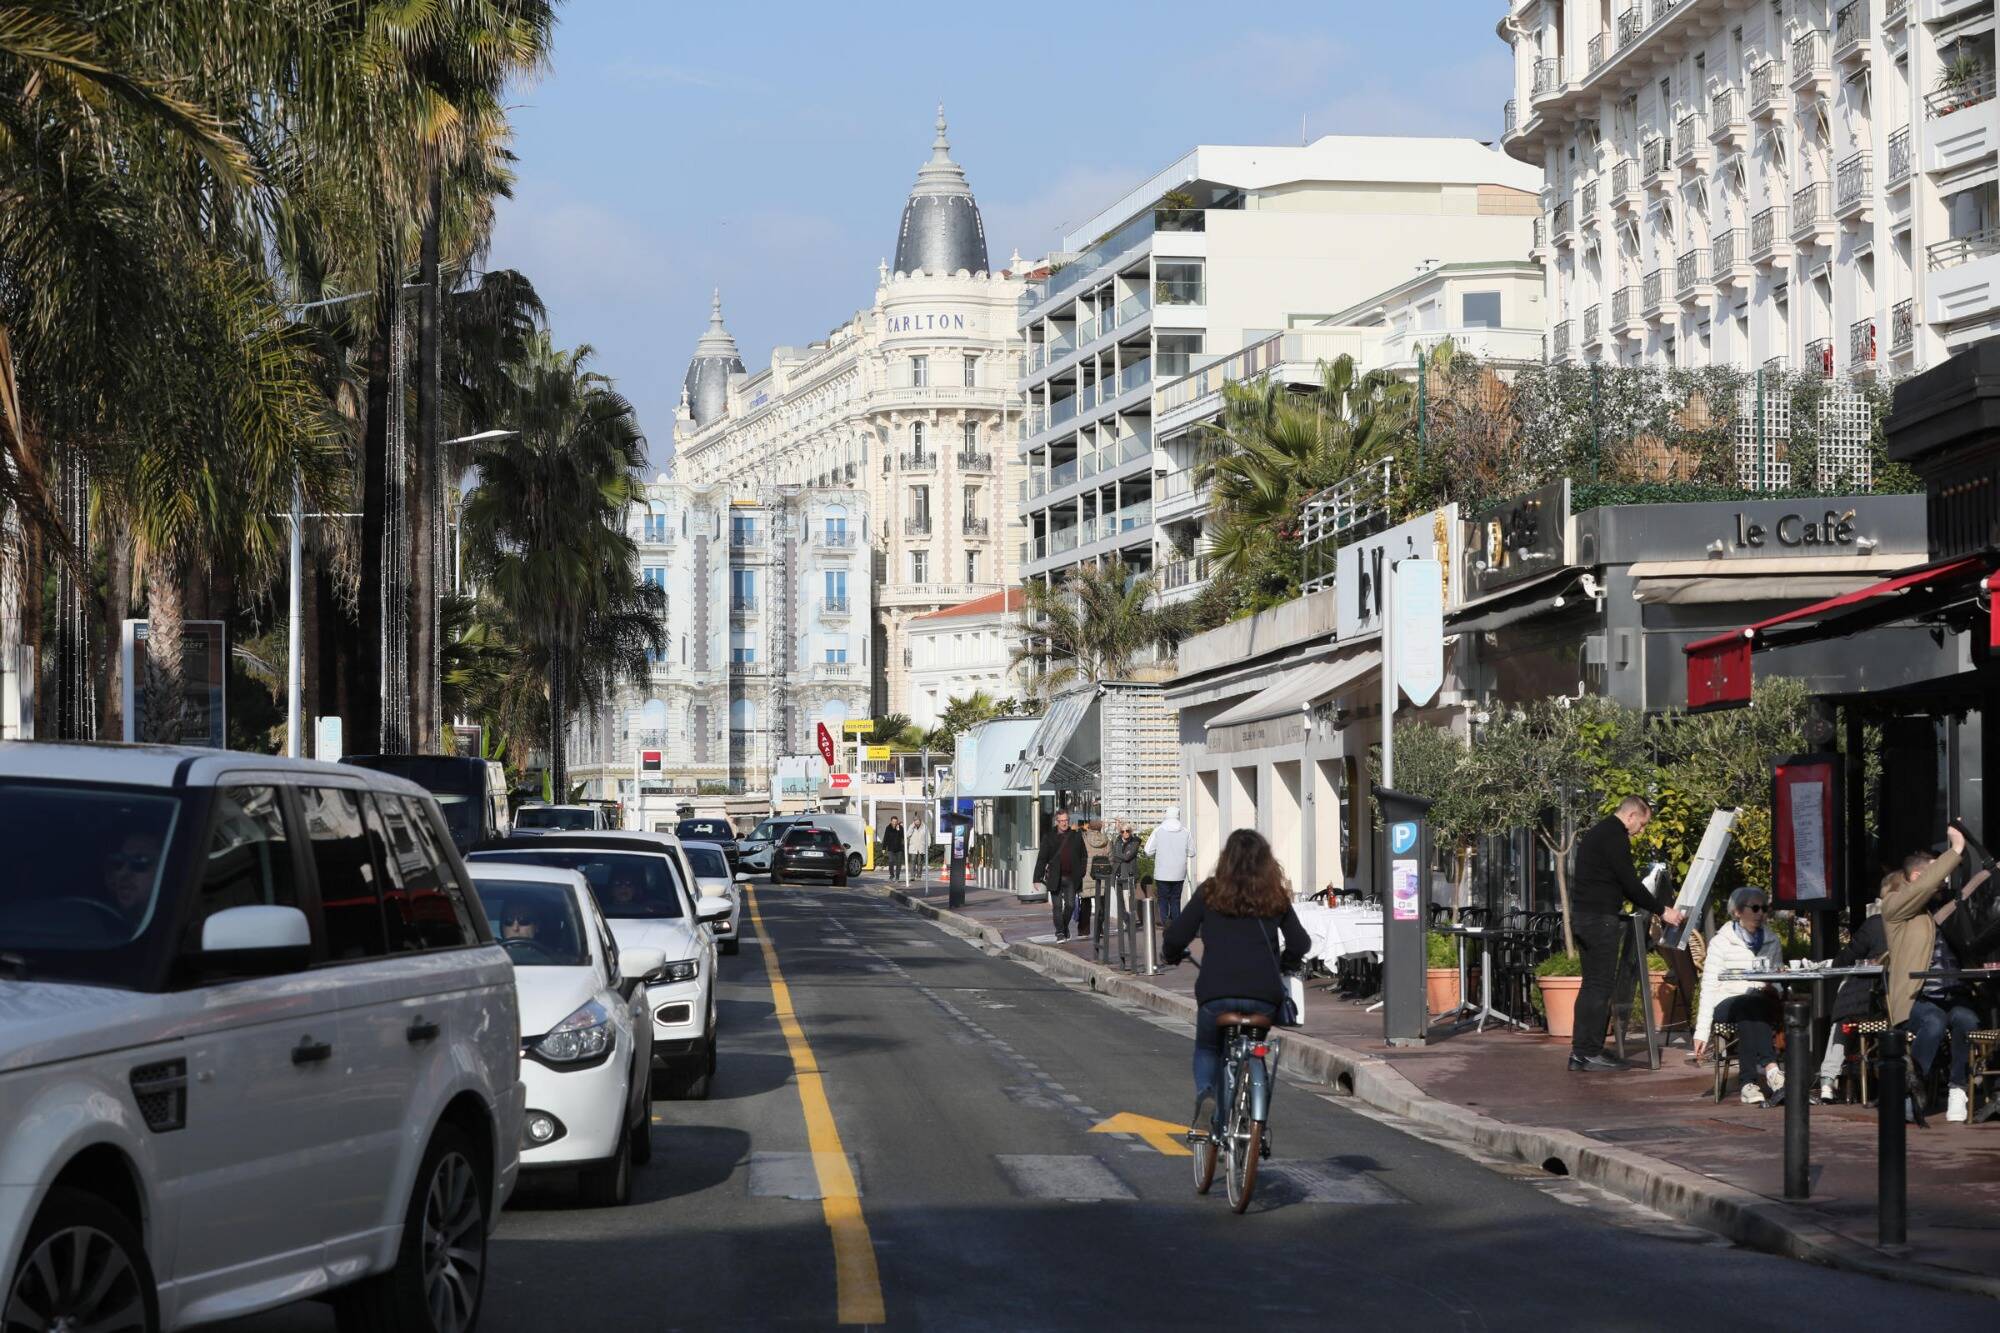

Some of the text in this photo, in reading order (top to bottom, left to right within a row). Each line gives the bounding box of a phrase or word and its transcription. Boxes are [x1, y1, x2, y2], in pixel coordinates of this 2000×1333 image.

[888, 314, 963, 333] CARLTON
[1735, 508, 1856, 548] le Café
[821, 732, 831, 756] TABAC
[1396, 826, 1410, 848] P
